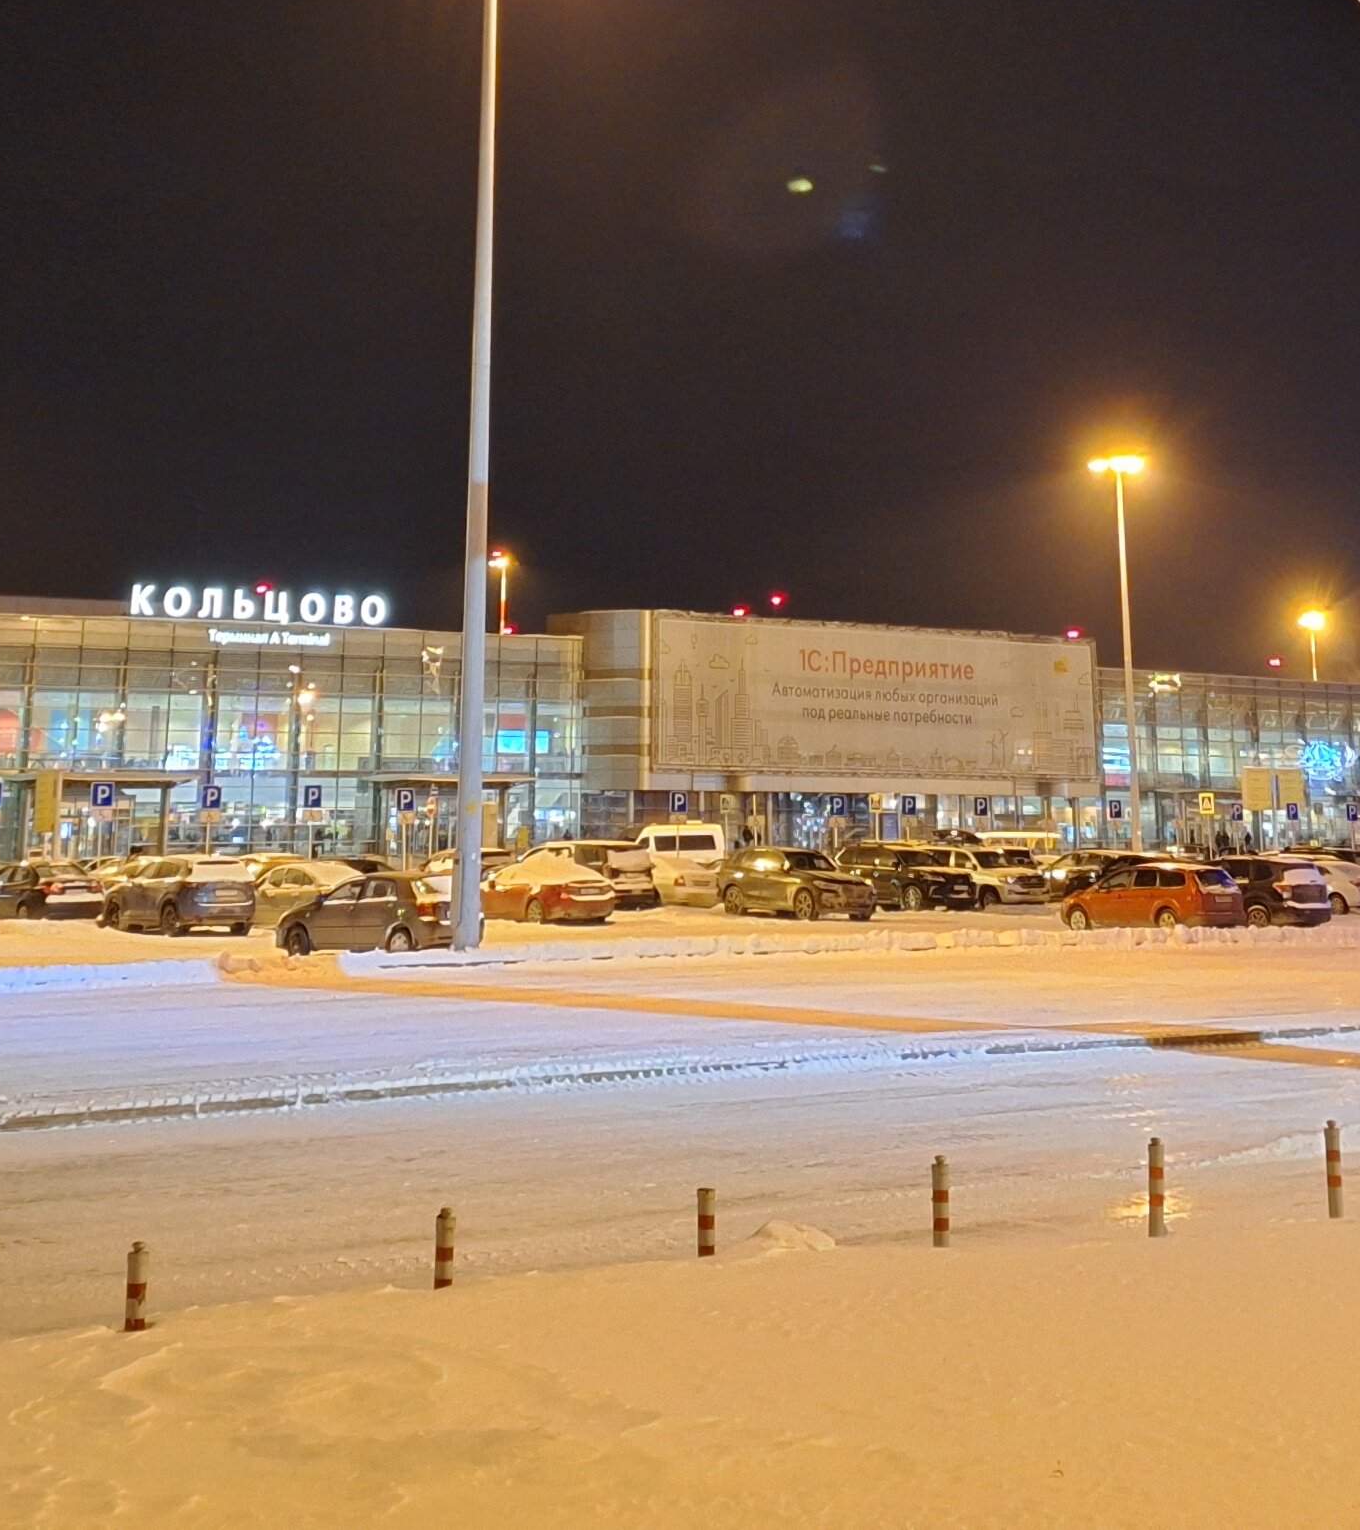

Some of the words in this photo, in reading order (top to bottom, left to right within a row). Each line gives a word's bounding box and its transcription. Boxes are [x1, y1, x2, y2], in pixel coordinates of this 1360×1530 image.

[130, 584, 386, 625] КОЛЬЦОВО
[799, 649, 974, 683] 1С:Предприятие
[772, 682, 871, 701] Автоматизация
[875, 687, 915, 703] любых
[919, 692, 998, 708] организаций
[802, 707, 826, 720] под
[829, 707, 890, 722] реальные
[894, 709, 972, 725] потребности
[97, 784, 110, 806] P
[207, 788, 218, 807] P
[308, 787, 319, 806] P
[400, 791, 411, 810] P
[674, 794, 685, 812] P
[833, 797, 843, 815] P
[904, 797, 914, 814] P
[976, 798, 986, 814] P
[1111, 802, 1119, 818] P
